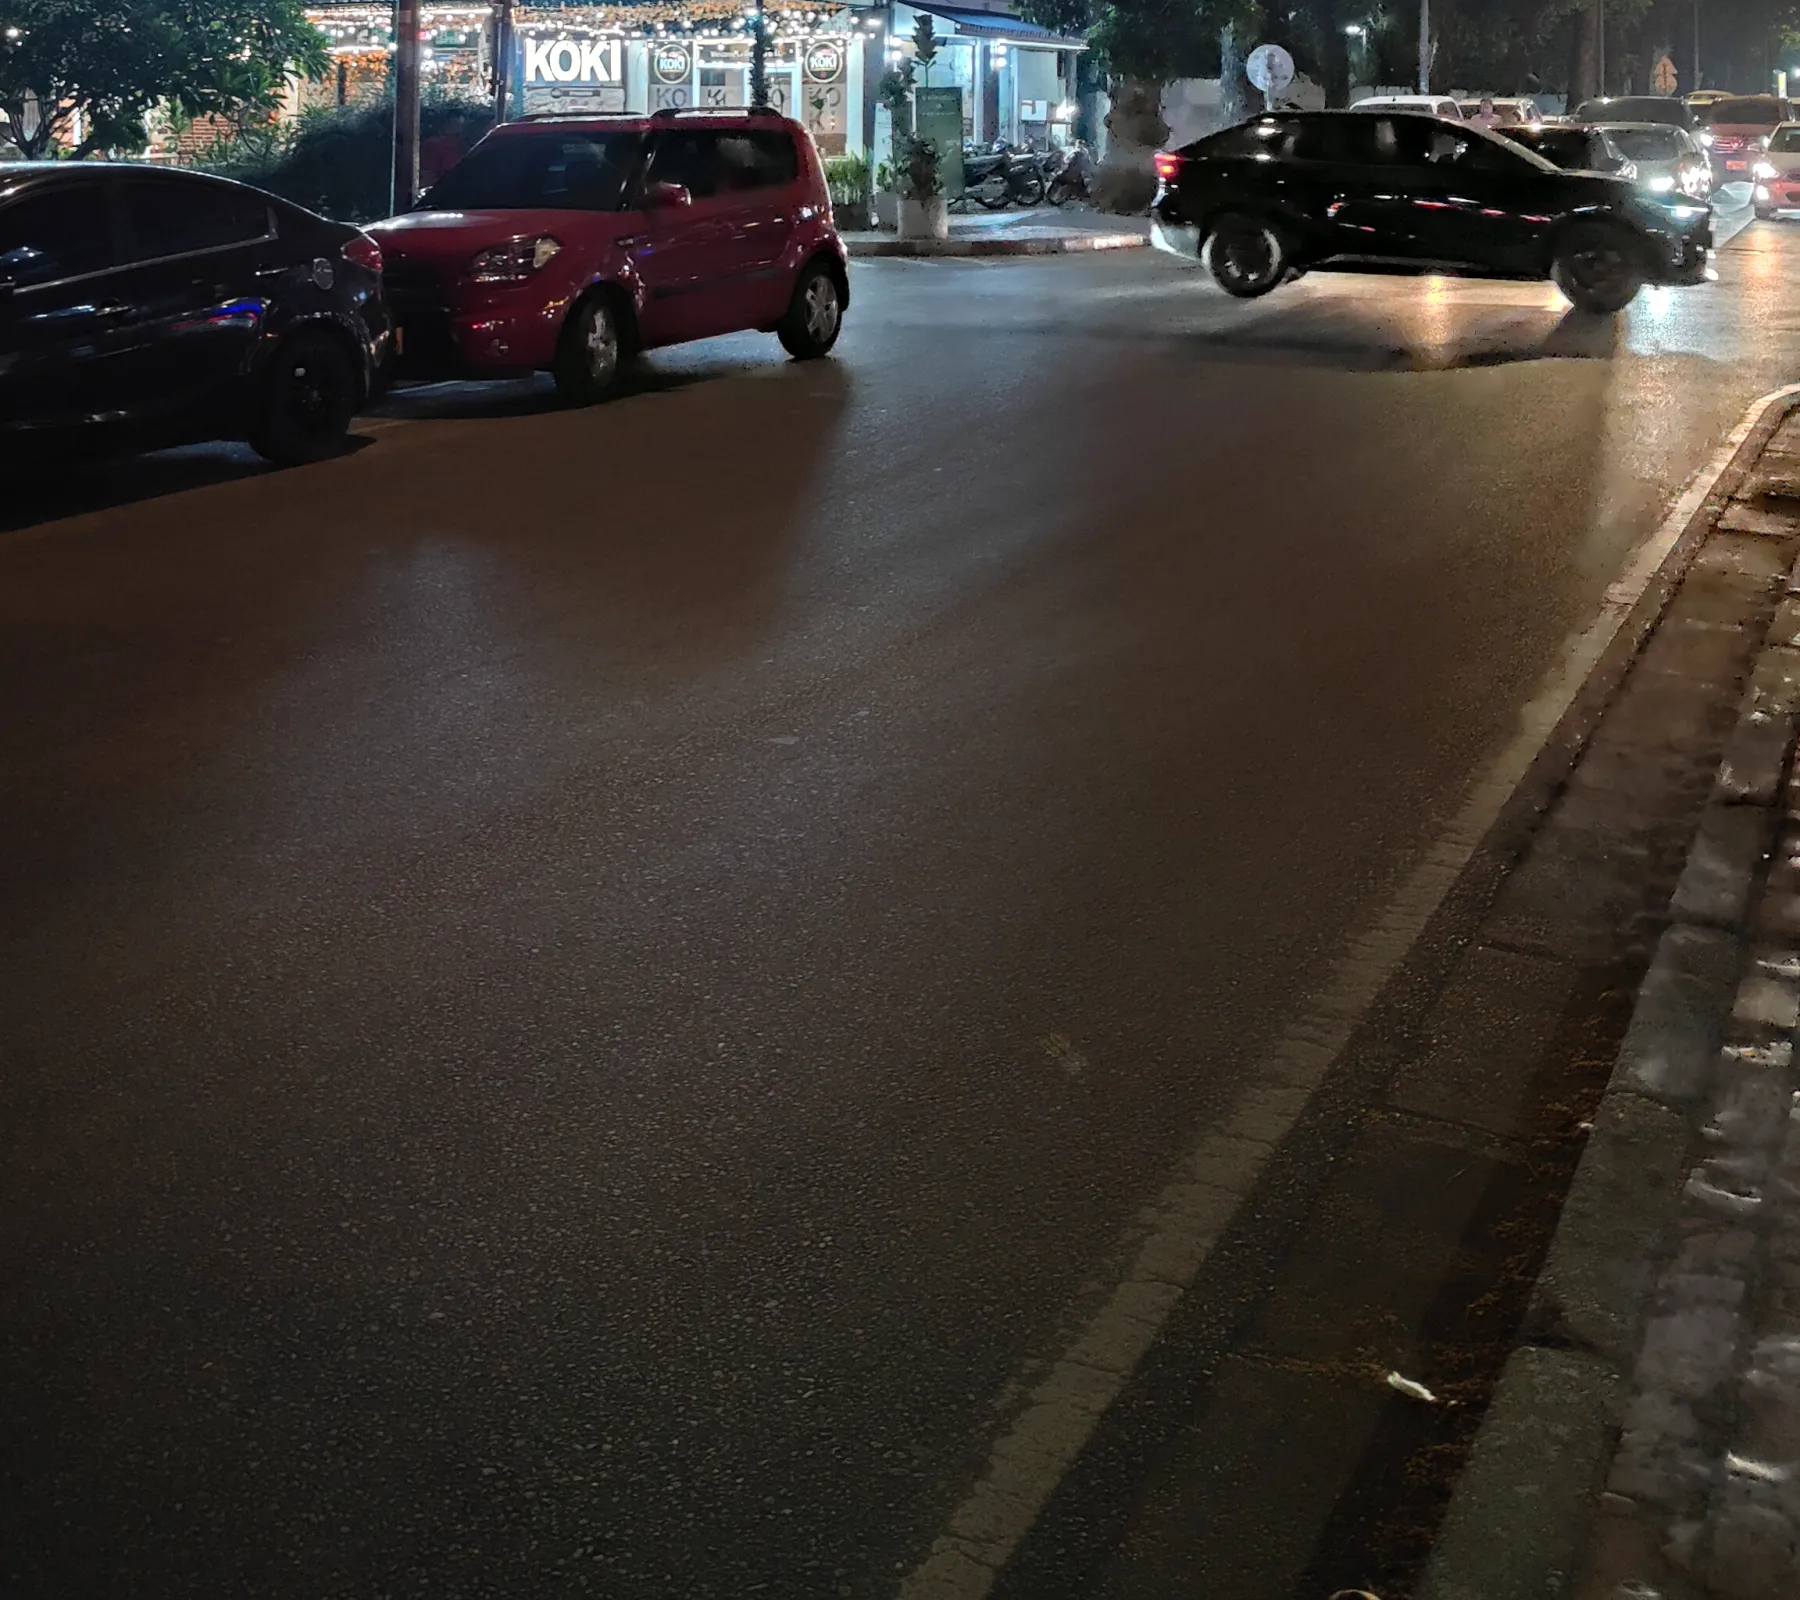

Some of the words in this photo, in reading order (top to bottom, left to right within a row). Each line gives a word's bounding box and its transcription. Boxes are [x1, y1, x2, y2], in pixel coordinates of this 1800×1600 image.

[525, 39, 622, 82] KOKI
[659, 58, 686, 70] KOKI
[810, 54, 838, 71] KOKI
[656, 88, 687, 107] KO
